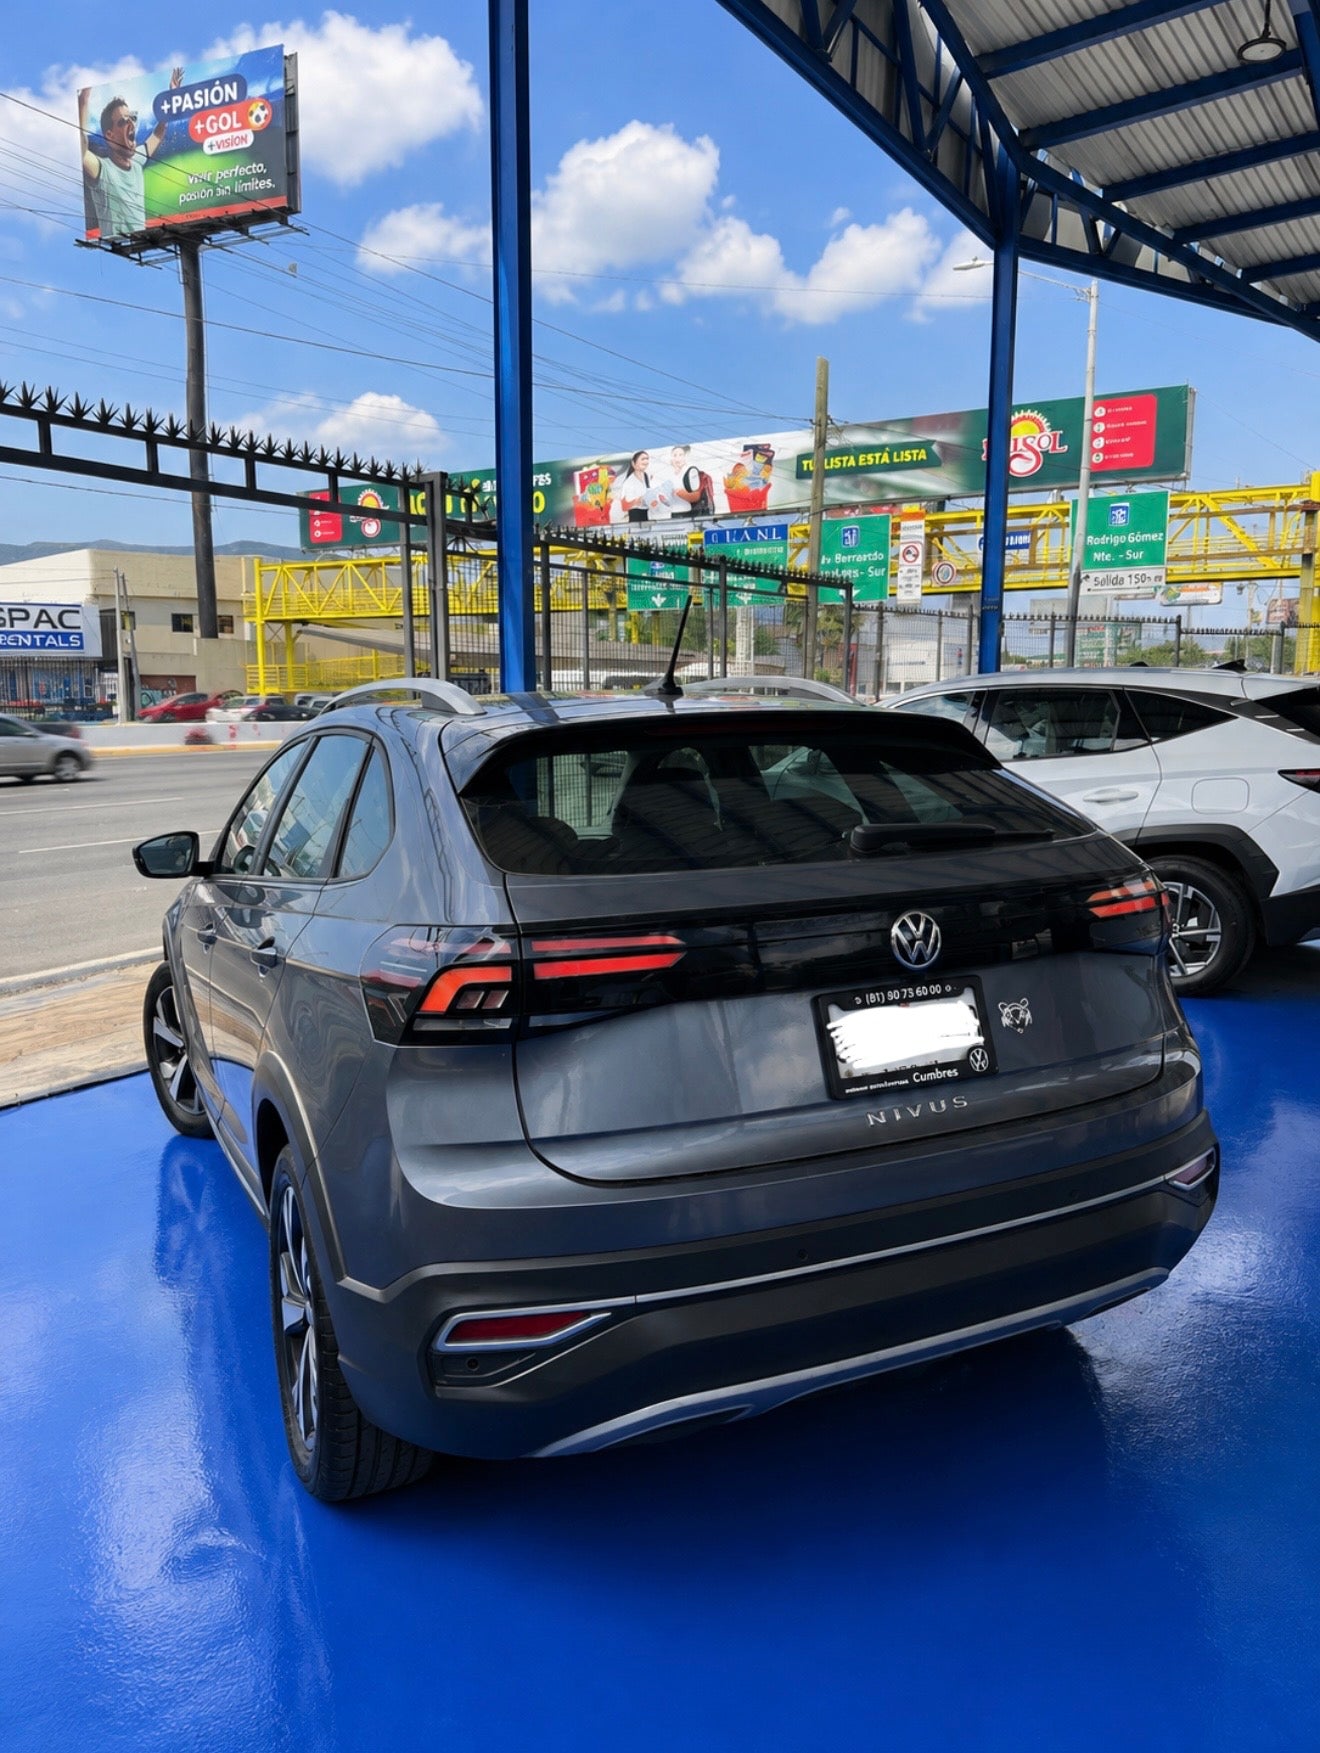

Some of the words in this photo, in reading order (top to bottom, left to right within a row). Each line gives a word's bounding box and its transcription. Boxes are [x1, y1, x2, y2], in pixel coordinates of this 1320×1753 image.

[161, 81, 238, 115] +PASIÓN
[195, 111, 243, 135] +GOL
[824, 455, 856, 469] LISTA
[893, 448, 927, 462] LISTA
[1087, 534, 1126, 547] Rodrigo
[1128, 531, 1165, 543] Gómez
[1126, 550, 1144, 560] Sur
[868, 566, 887, 577] Sur
[913, 1068, 959, 1087] Cumbres
[866, 1095, 969, 1127] NIVUS
